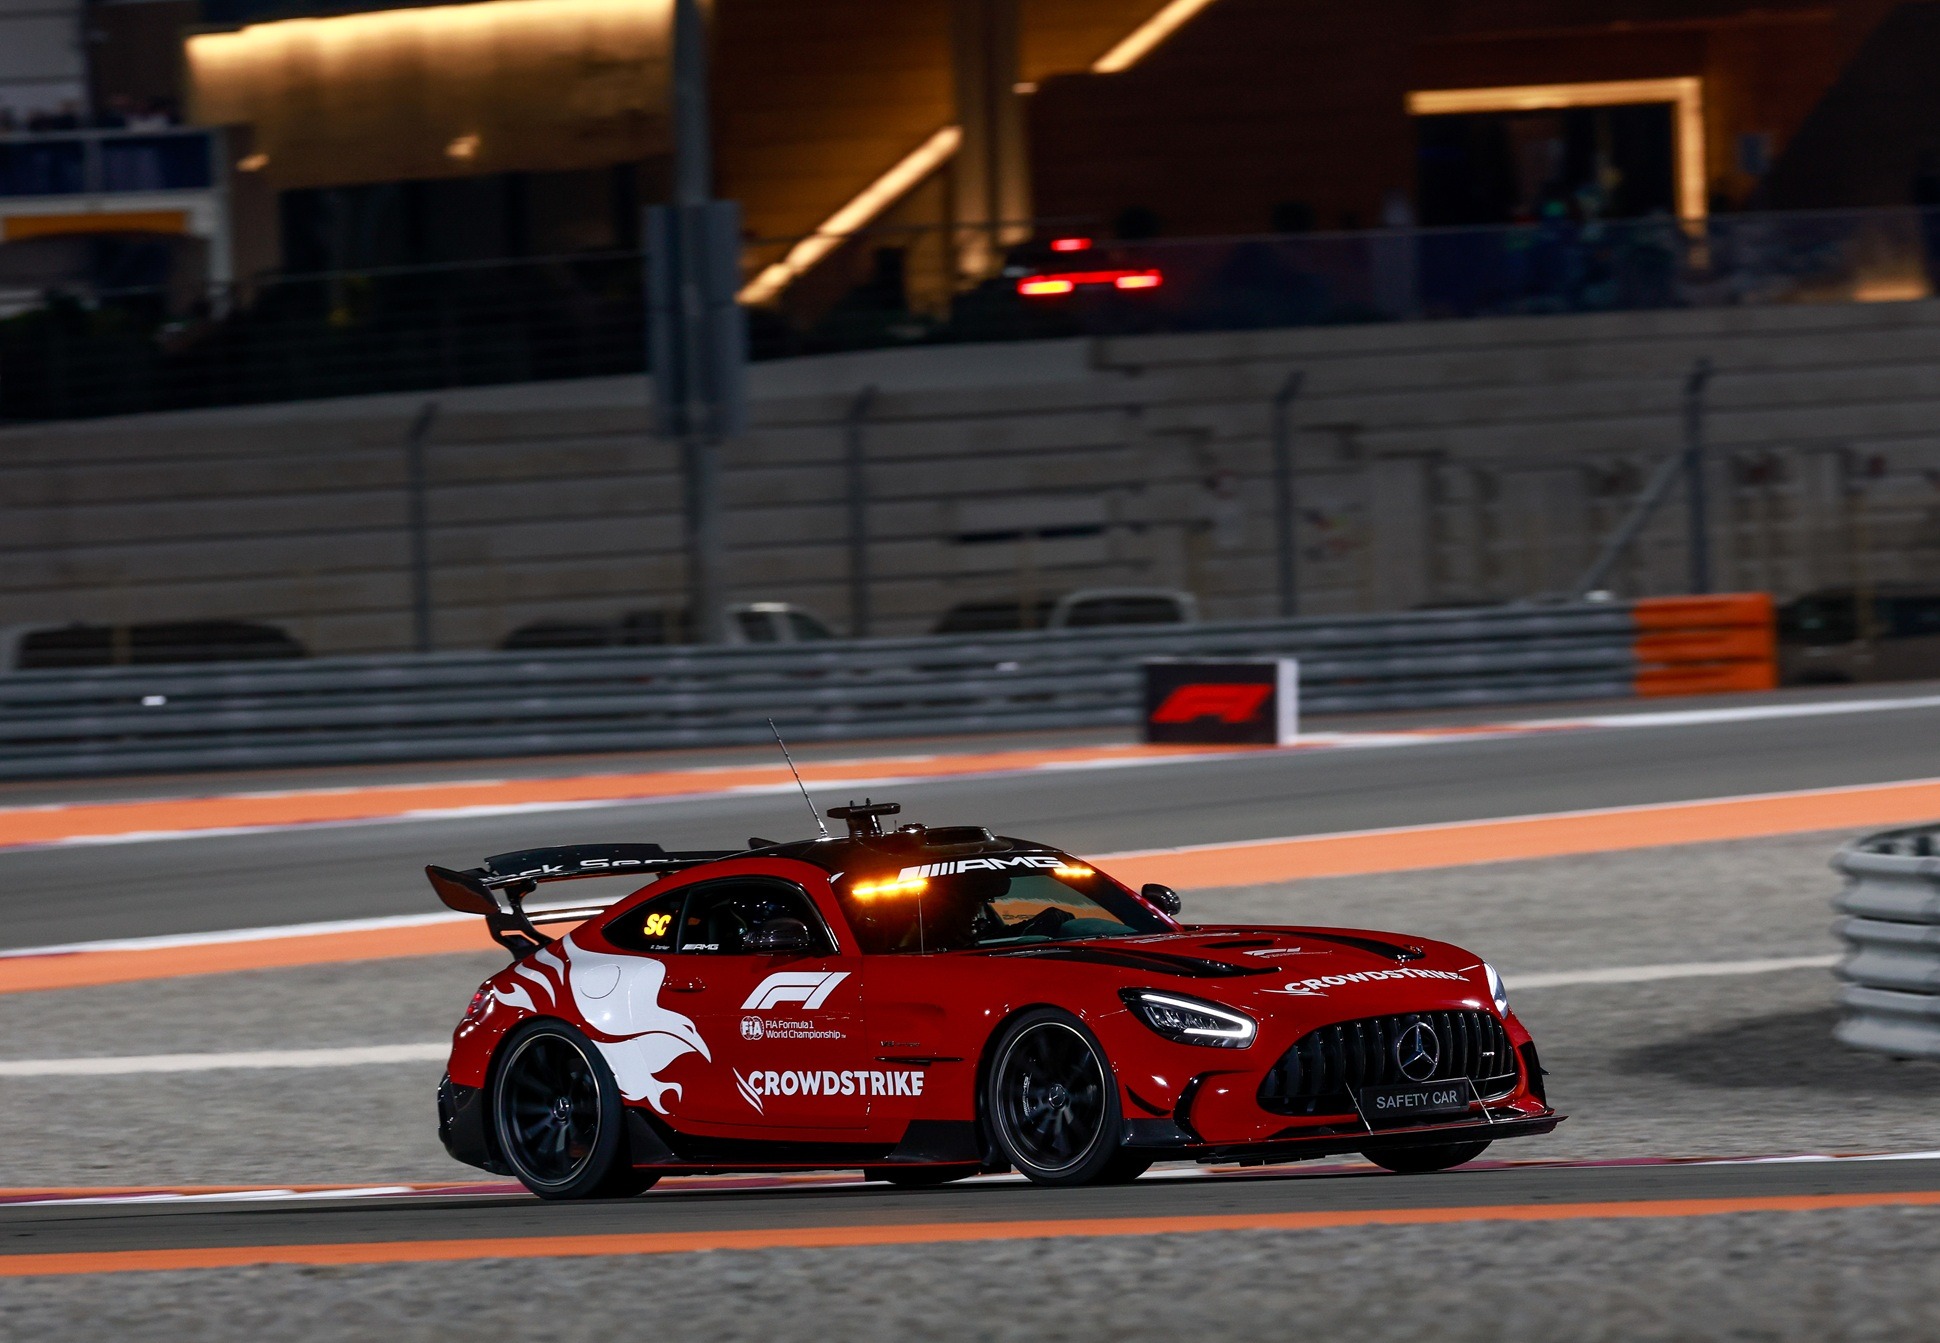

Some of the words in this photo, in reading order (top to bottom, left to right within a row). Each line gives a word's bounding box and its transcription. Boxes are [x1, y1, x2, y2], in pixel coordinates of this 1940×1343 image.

[643, 913, 671, 936] SC
[740, 971, 851, 1010] F1
[765, 1020, 778, 1029] FIA
[779, 1020, 809, 1029] Formula
[809, 1020, 814, 1029] 1
[766, 1030, 788, 1039] World
[788, 1030, 841, 1040] Championship
[748, 1070, 924, 1096] CROWDSTRIKE
[1376, 1092, 1429, 1109] SAFETY
[1432, 1090, 1458, 1104] CAR
